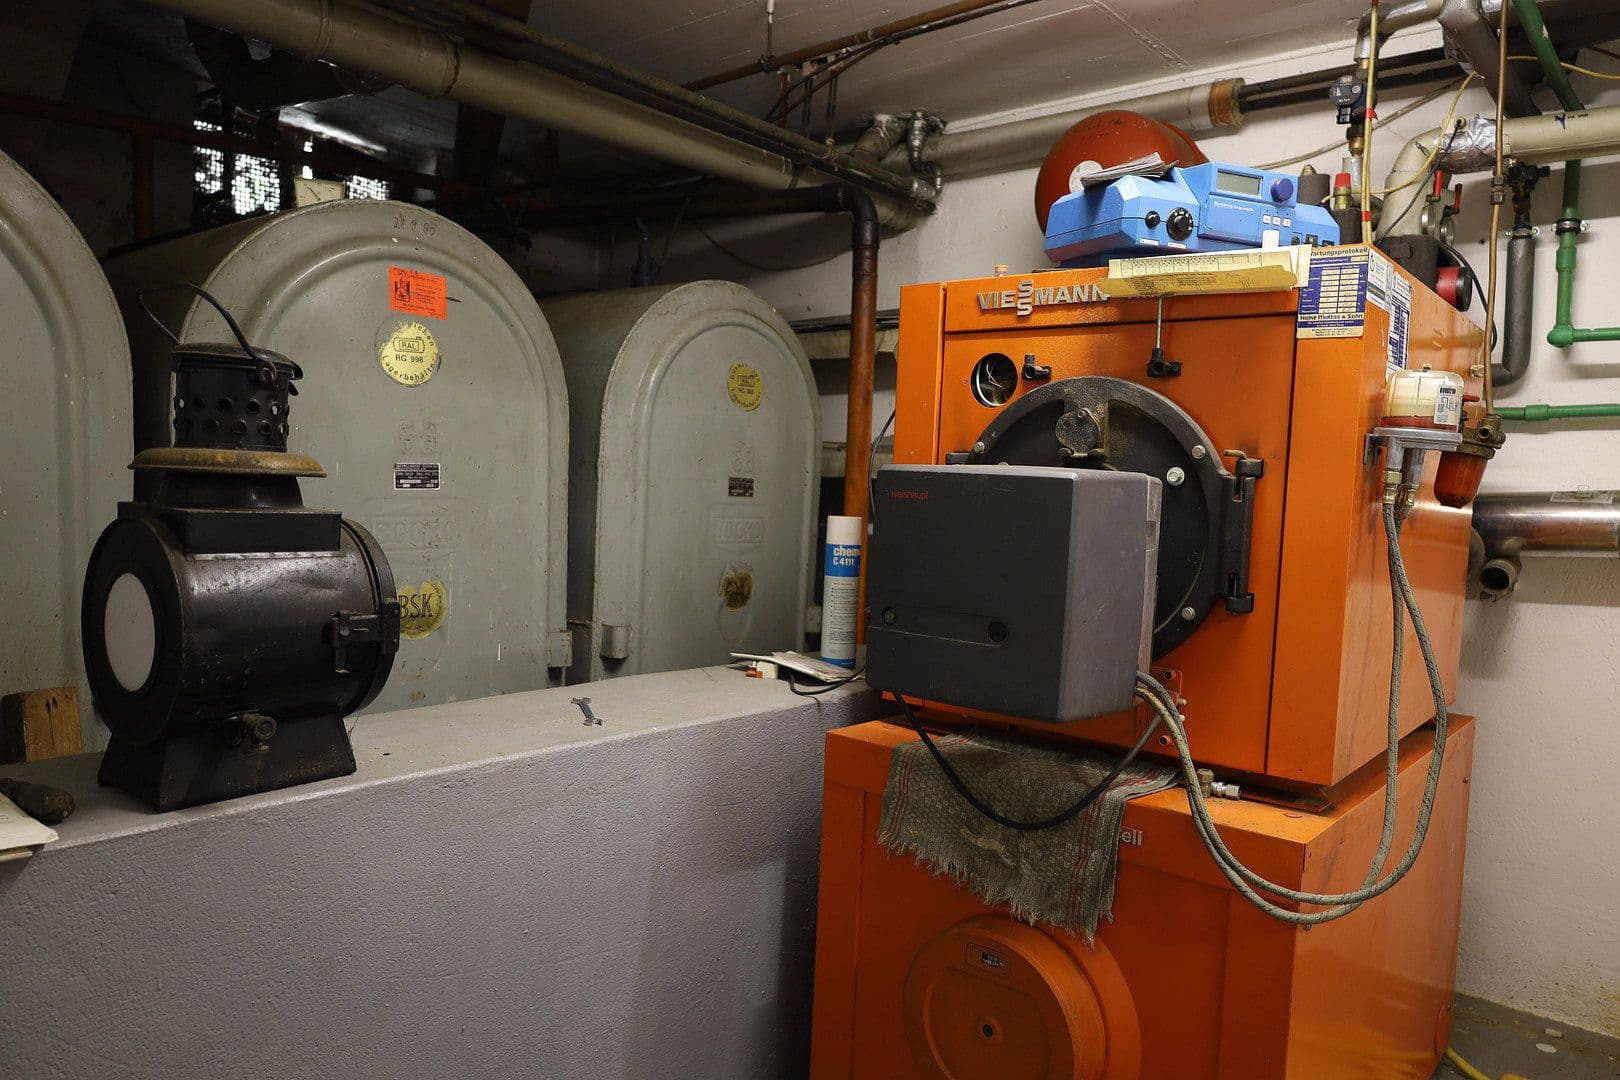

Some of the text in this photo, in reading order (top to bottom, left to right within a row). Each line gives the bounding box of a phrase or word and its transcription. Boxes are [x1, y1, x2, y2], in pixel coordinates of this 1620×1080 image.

[978, 279, 1110, 317] VIESSMANN
[401, 340, 417, 350] RAL
[396, 354, 424, 363] RG 998
[398, 593, 434, 619] BSK
